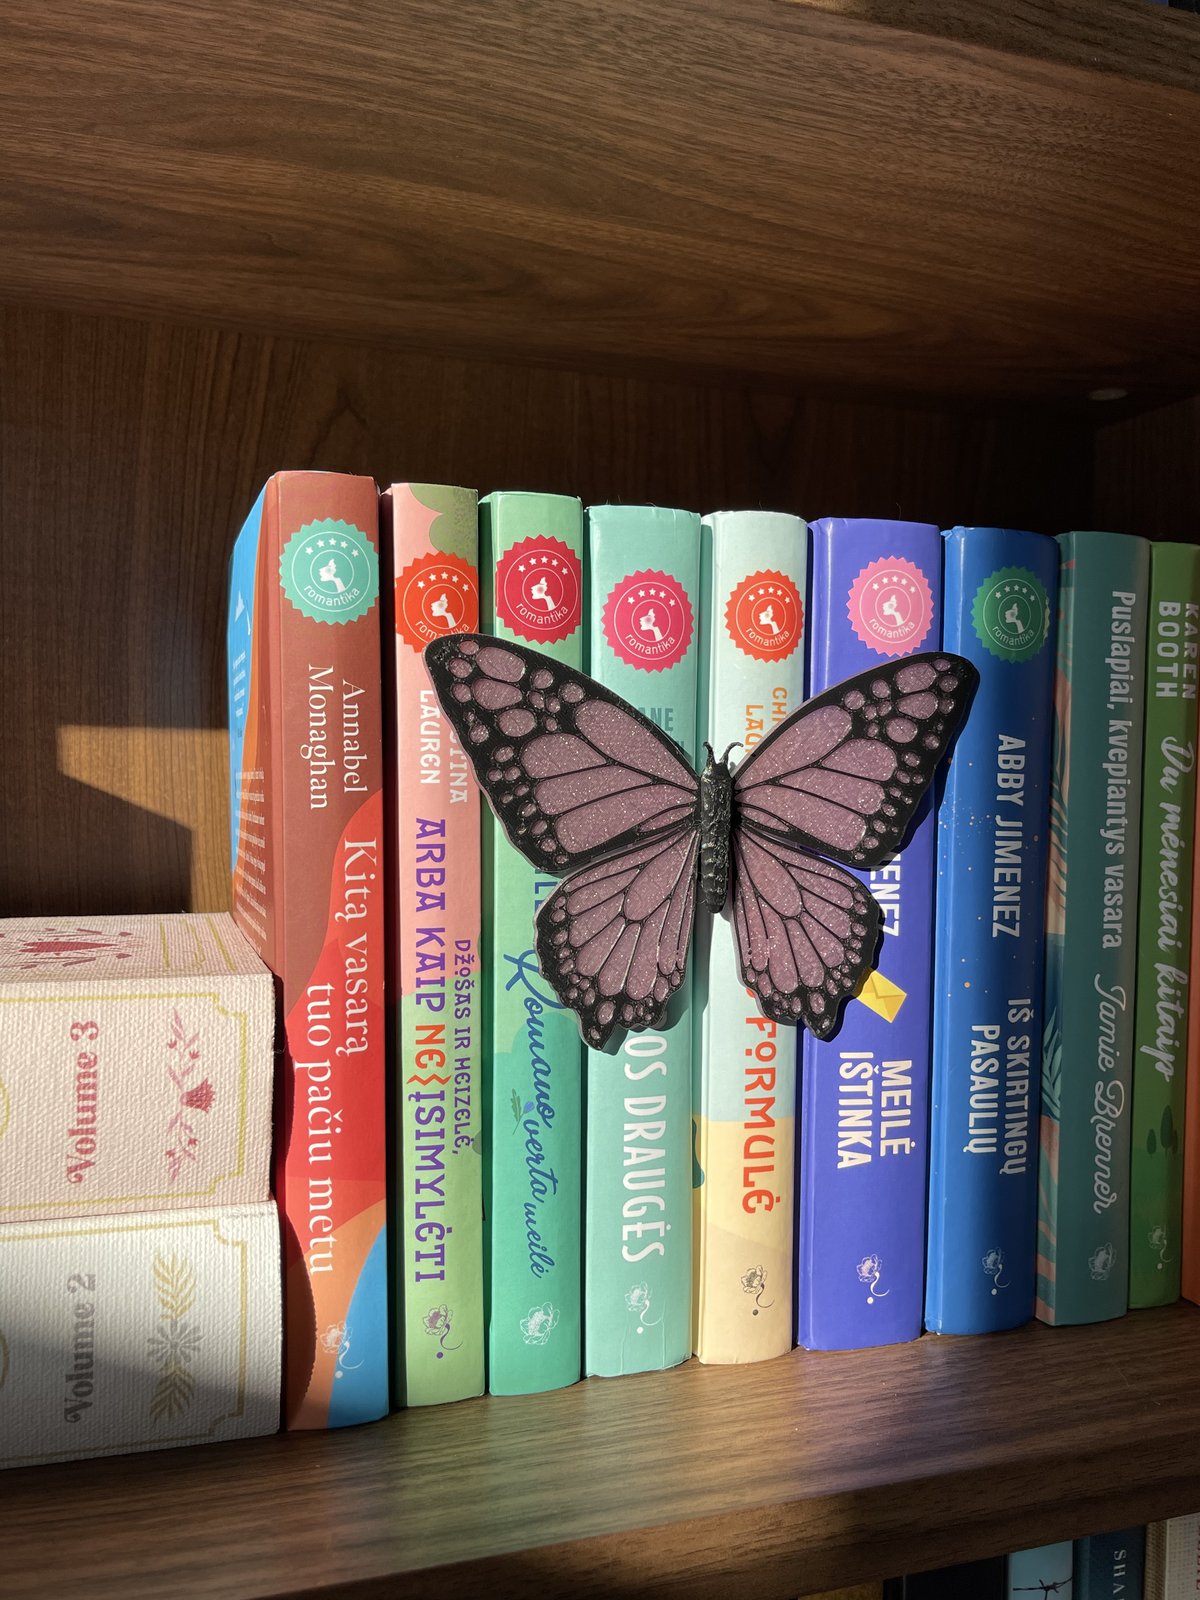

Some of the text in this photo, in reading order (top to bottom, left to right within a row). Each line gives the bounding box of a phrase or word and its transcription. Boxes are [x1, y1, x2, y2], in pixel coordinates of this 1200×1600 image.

[303, 585, 360, 606] romantika
[515, 602, 569, 625] romantika
[625, 634, 676, 655] romantika
[745, 627, 790, 647] romantika
[868, 617, 915, 638] romantika
[992, 626, 1035, 646] romantika
[1156, 601, 1181, 697] BOOTH
[1182, 603, 1199, 699] KAREN
[300, 664, 335, 810] Monaghan
[342, 680, 368, 794] Annabel
[420, 690, 441, 784] LAUREN
[1100, 591, 1136, 948] Puslapiai, kvepiantys vasara
[415, 817, 447, 912] ARBA
[991, 733, 1026, 939] ABBY JIMENEZ
[335, 838, 378, 1056] Kitą vasarą
[1139, 736, 1195, 1082] Du mėnesiai kitaip
[415, 927, 446, 1012] KAIP
[455, 1027, 471, 1050] IR
[999, 998, 1034, 1175] IŠ SKIRTINGŲ
[66, 1020, 99, 1185] Volume 3
[295, 982, 343, 1275] tuo pačiu metu
[837, 1051, 879, 1169] IŠTINKA
[879, 1059, 916, 1157] MEILĖ
[963, 1024, 1000, 1153] PASAULIŲ
[1090, 973, 1126, 1214] Jamie Brenner
[523, 1119, 559, 1203] verta
[621, 1095, 672, 1263] DRAUGĖS
[523, 1202, 556, 1279] meilė
[64, 1273, 96, 1424] Volume 2
